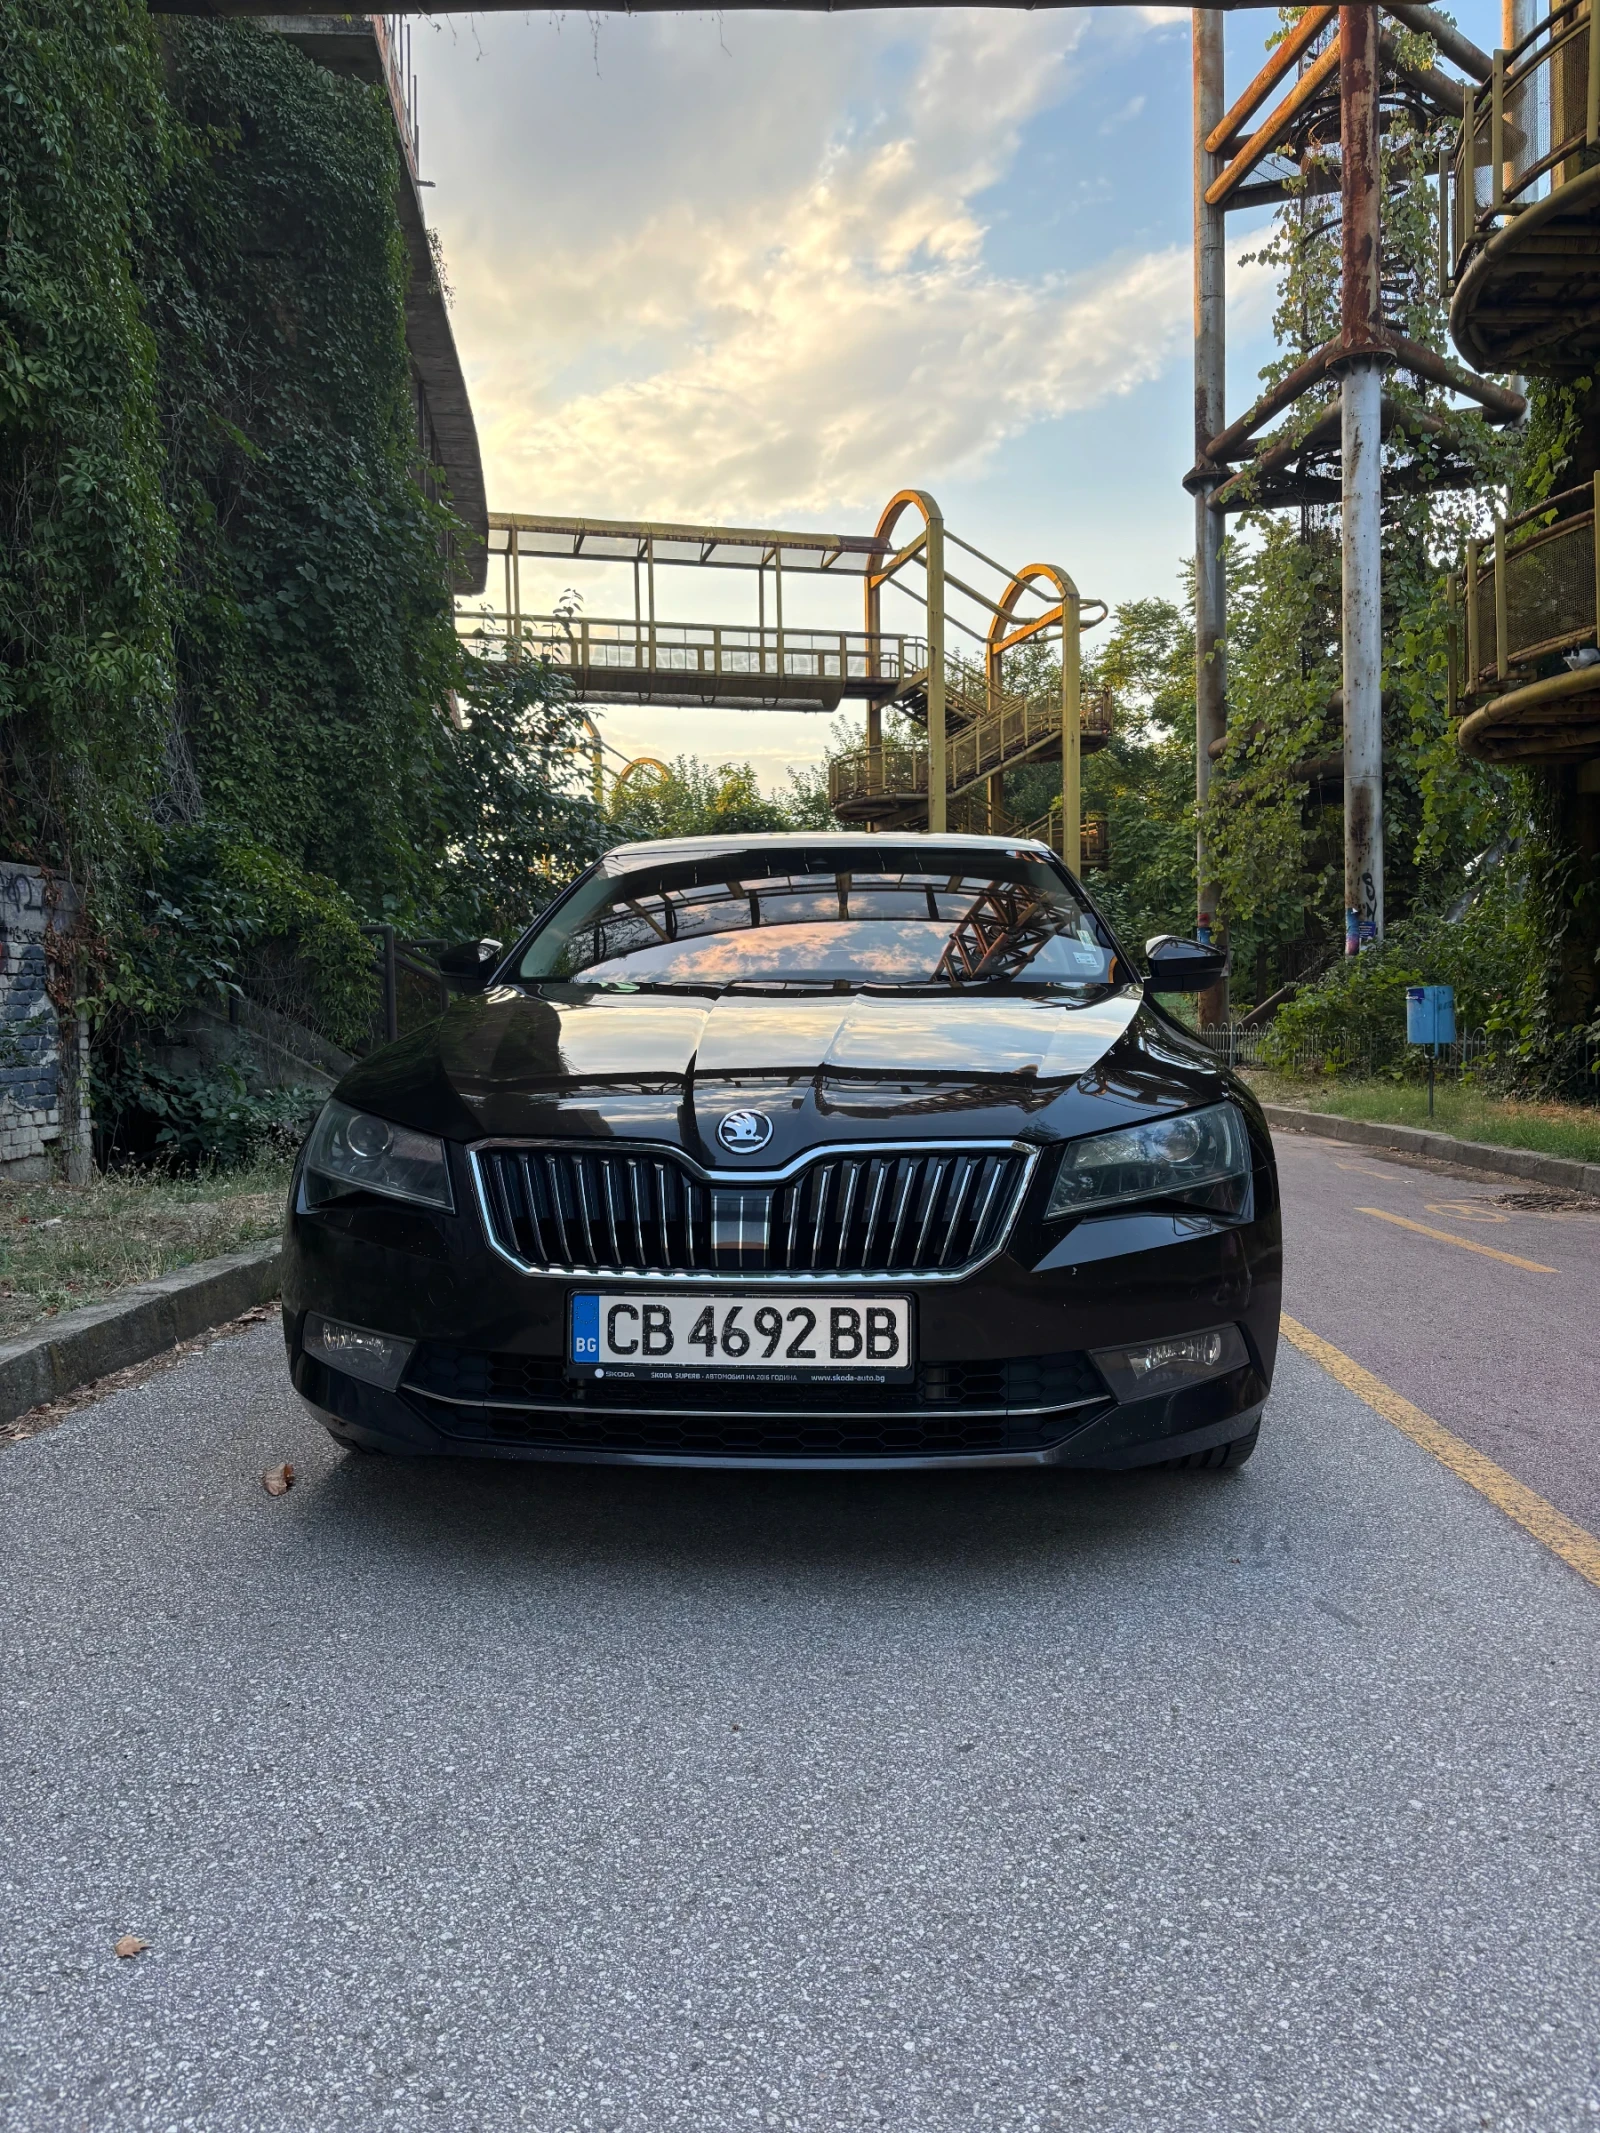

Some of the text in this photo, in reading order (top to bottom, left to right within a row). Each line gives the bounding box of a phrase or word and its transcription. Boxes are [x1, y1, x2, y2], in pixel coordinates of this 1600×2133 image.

[608, 1304, 899, 1359] CB 4692 BB
[576, 1338, 597, 1352] BG
[811, 1373, 885, 1383] www.skoda-auto.bg
